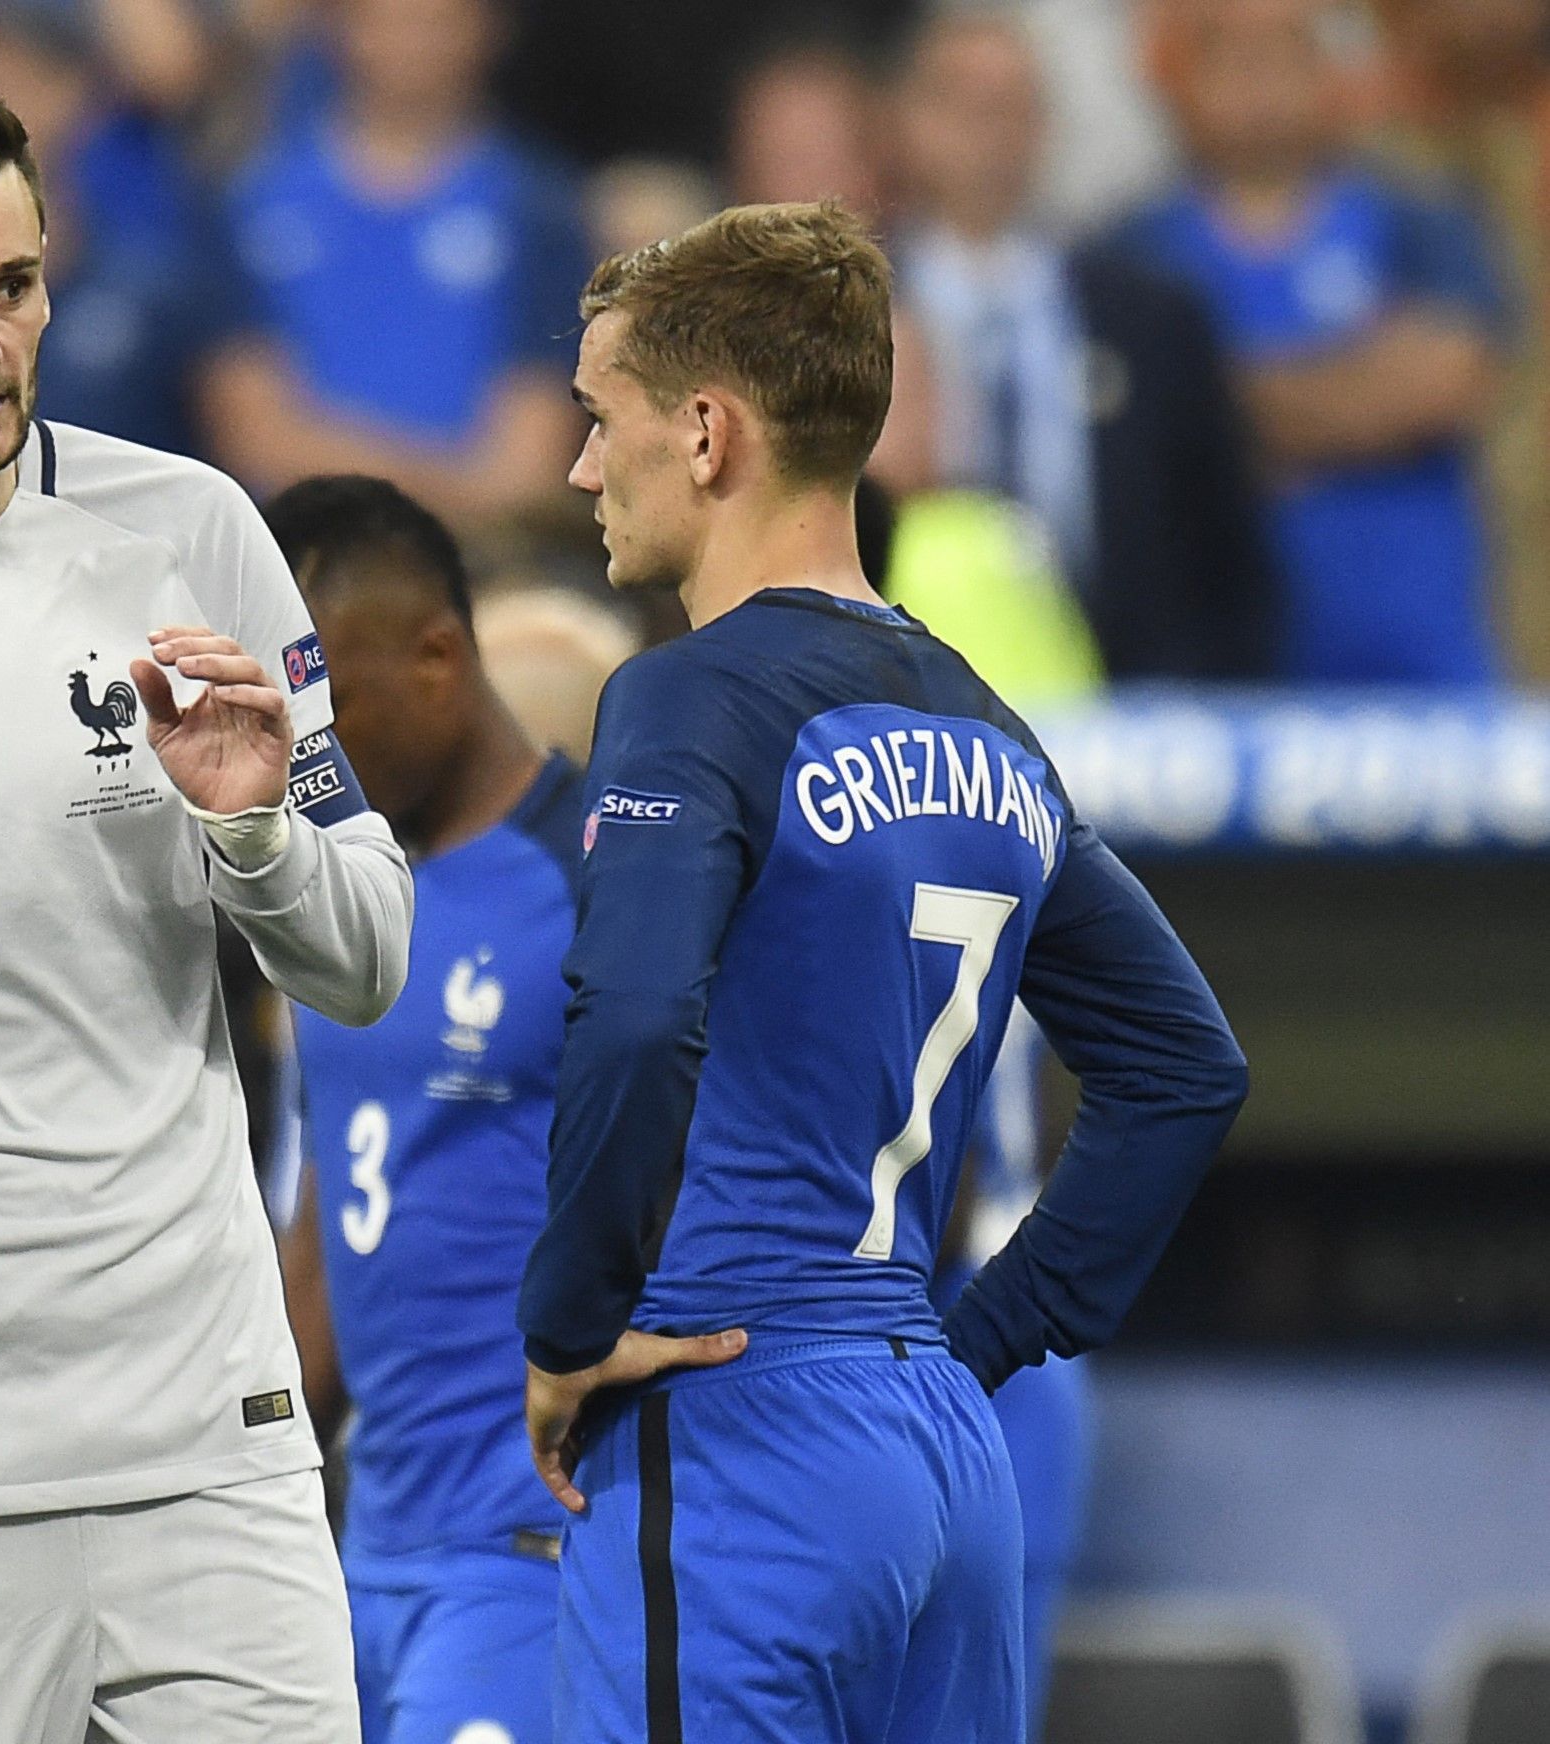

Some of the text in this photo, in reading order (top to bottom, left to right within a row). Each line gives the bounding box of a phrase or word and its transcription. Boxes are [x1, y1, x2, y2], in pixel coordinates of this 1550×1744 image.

[289, 732, 332, 764] CISM
[852, 882, 1020, 1261] 7
[342, 1100, 391, 1256] 3
